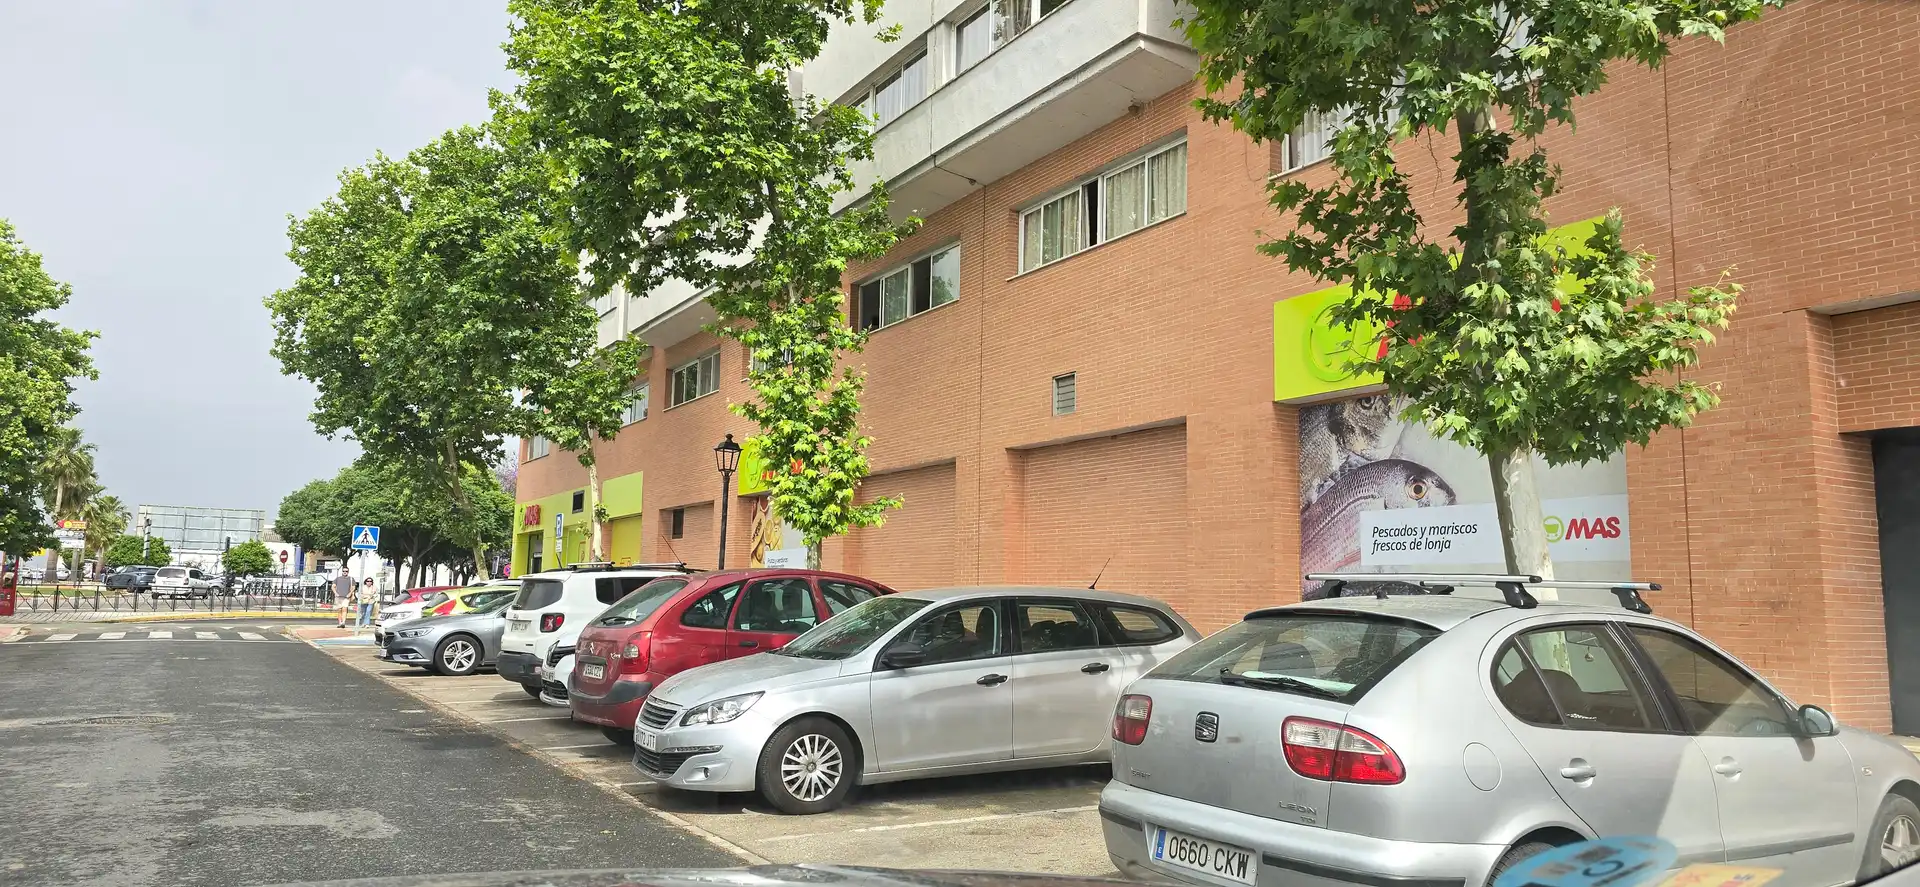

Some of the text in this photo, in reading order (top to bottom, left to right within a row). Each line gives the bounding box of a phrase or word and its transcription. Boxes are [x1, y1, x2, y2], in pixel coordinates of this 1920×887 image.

[1372, 522, 1478, 539] Pescados y mariscos
[1565, 516, 1621, 540] MAS
[1371, 537, 1451, 555] frescos de lonja
[1279, 801, 1316, 815] LEON
[1301, 816, 1315, 824] TDI
[1169, 836, 1249, 879] 0660 CKW
